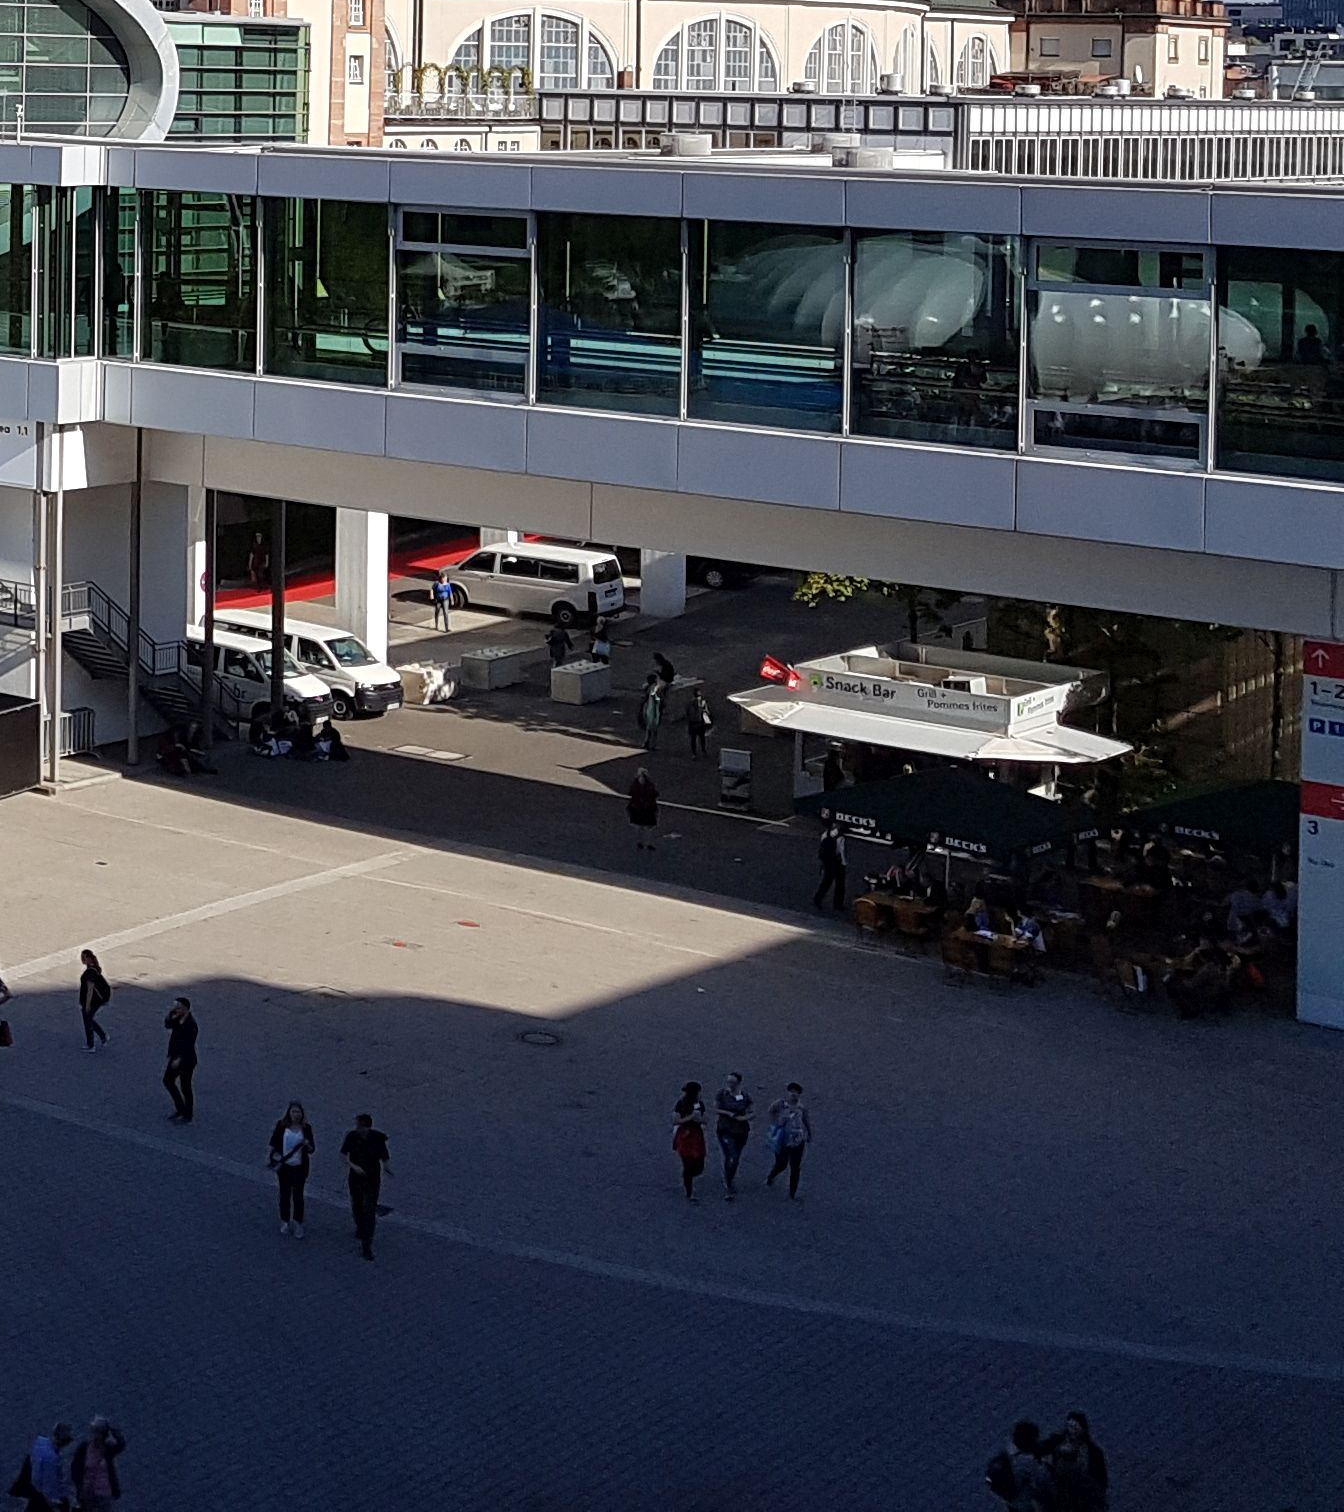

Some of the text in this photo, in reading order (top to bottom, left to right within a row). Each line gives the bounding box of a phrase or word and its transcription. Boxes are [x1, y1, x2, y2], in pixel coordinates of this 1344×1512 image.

[16, 425, 28, 436] 1.1
[826, 676, 896, 700] Snack Bar
[917, 688, 937, 699] Grill
[927, 699, 970, 710] Pommes
[1313, 720, 1322, 731] P
[835, 811, 876, 828] BECK'S
[1307, 820, 1319, 835] 3
